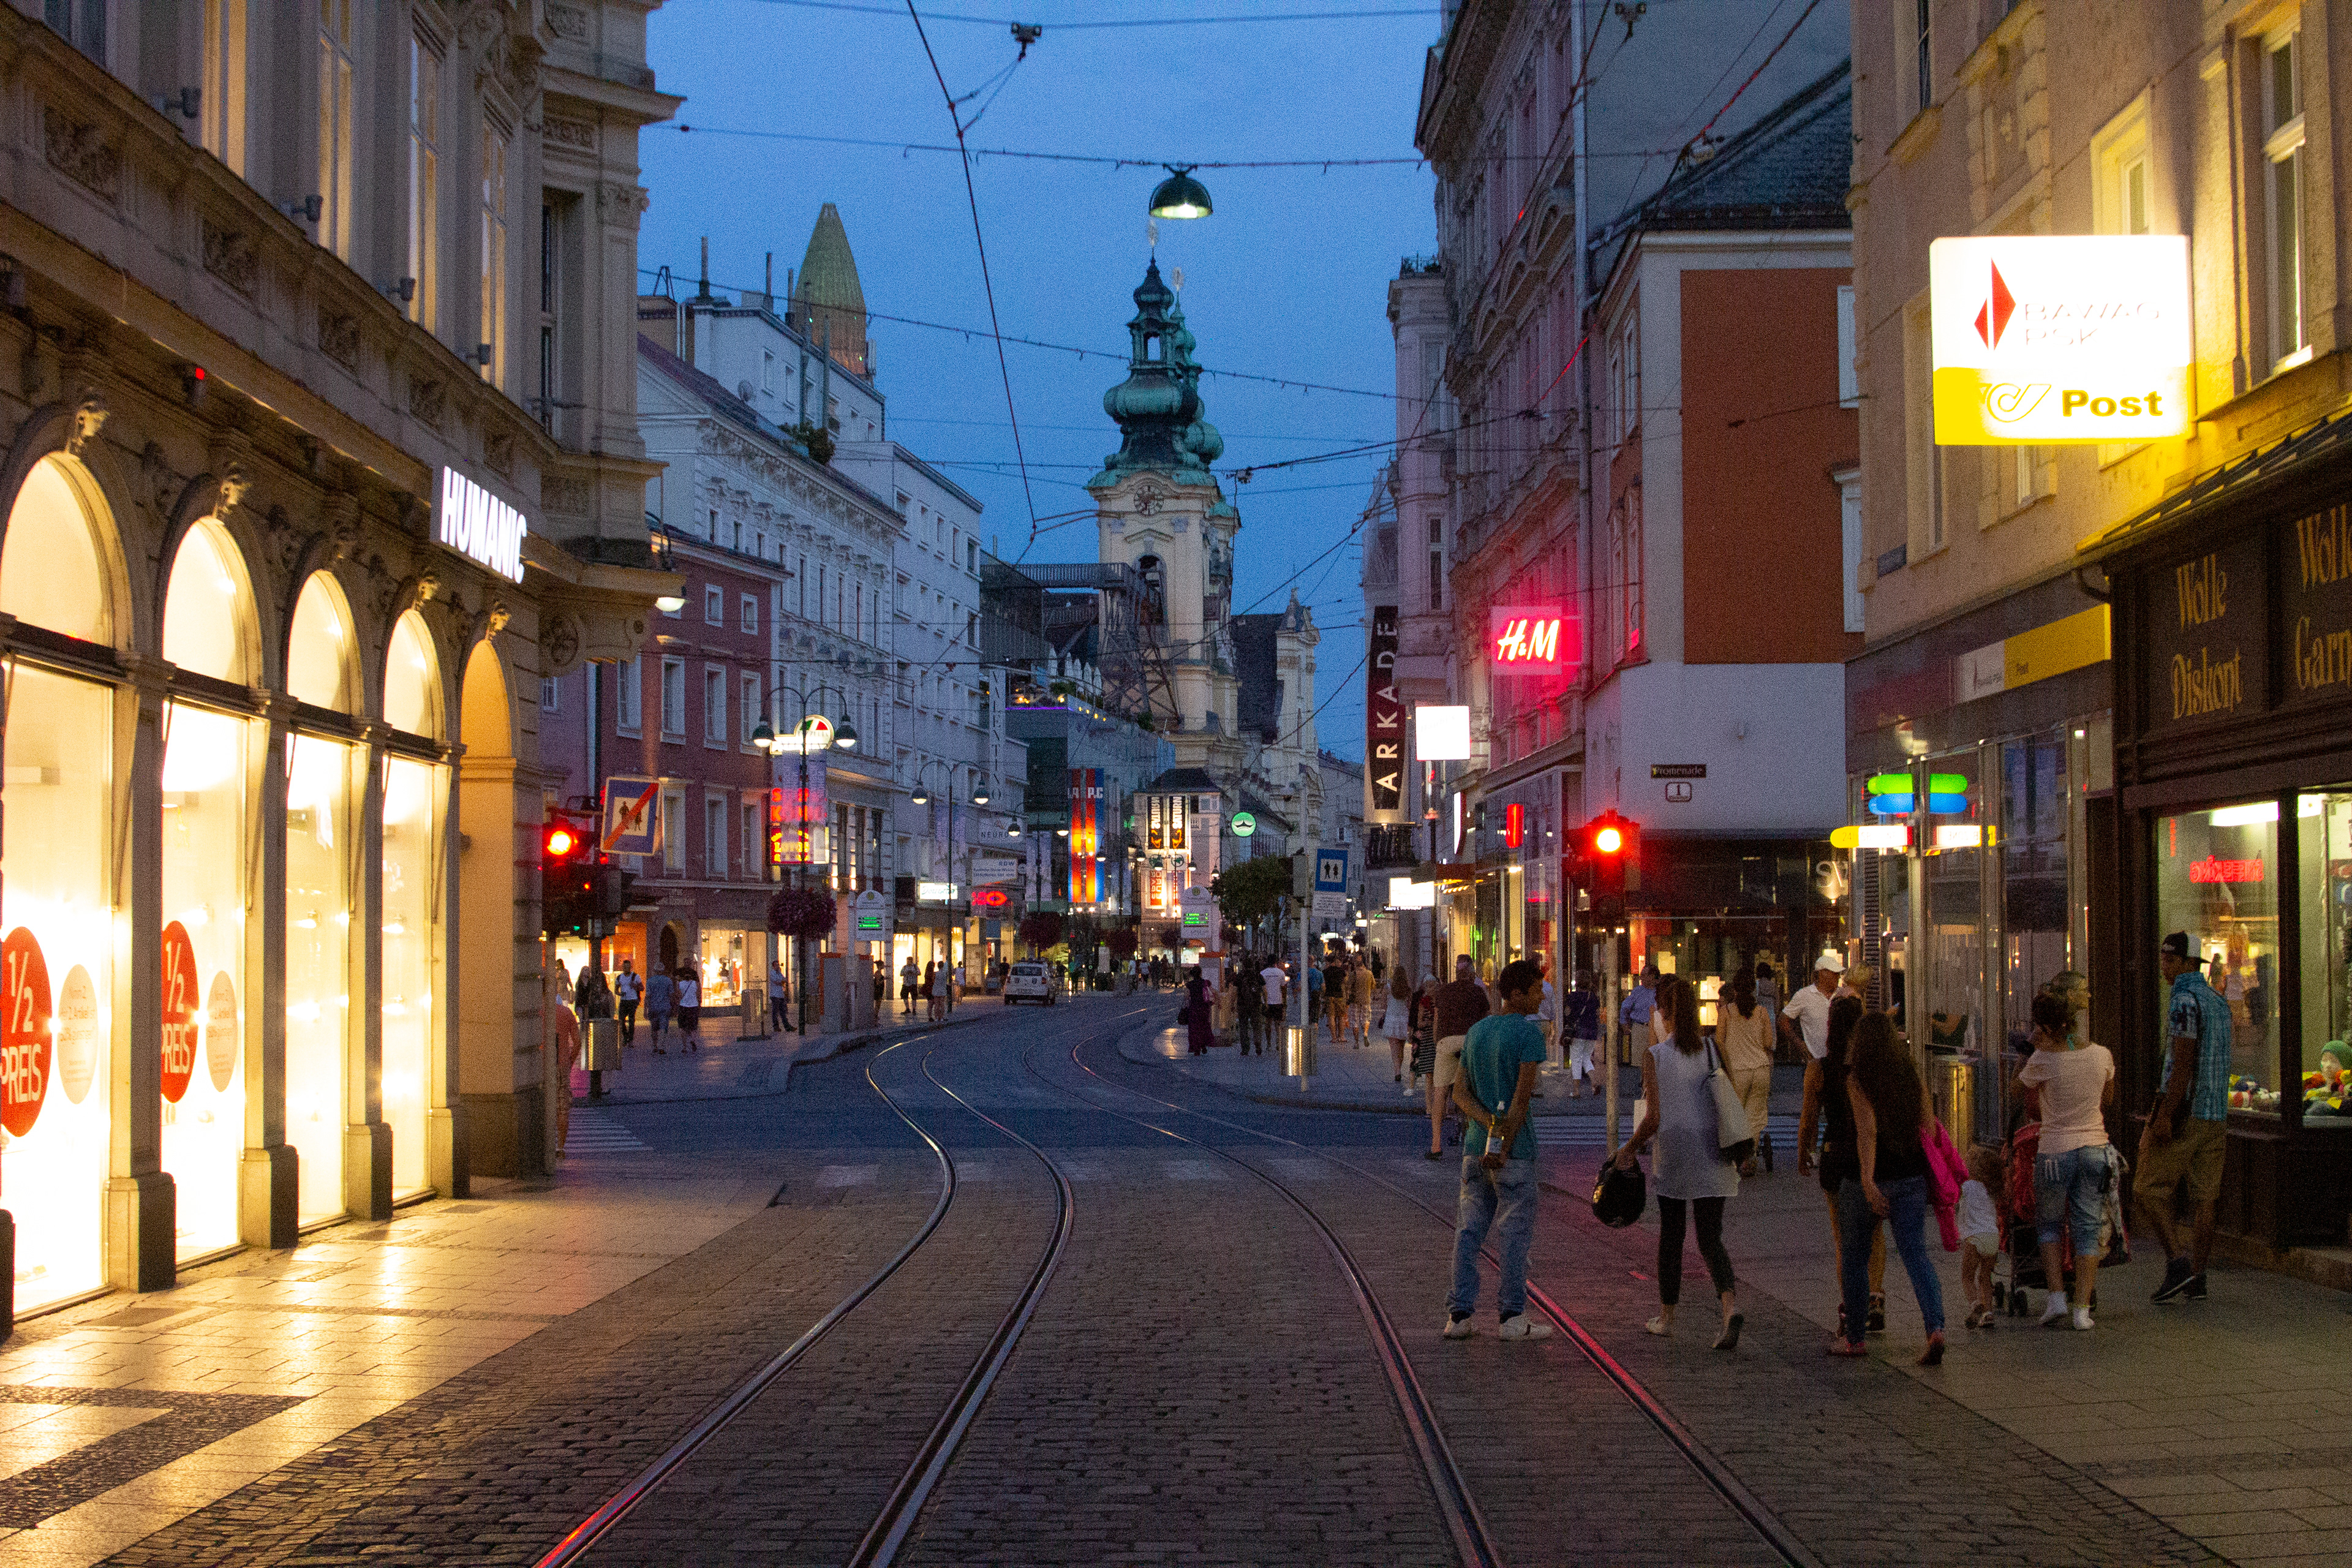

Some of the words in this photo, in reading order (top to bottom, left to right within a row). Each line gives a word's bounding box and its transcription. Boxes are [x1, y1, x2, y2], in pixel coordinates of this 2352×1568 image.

[2024, 302, 2160, 320] BAWAG
[2025, 328, 2098, 346] PSK
[2062, 390, 2163, 417] Post
[440, 466, 527, 584] HUMANIC
[2176, 554, 2227, 632] Wolle
[1497, 619, 1560, 662] H&M
[1376, 623, 1398, 792] ARKADE
[2171, 647, 2242, 719] Diskont
[1653, 766, 1703, 775] Promenade
[1172, 796, 1183, 829] SATURN
[9, 951, 34, 1033] 1/2
[166, 941, 185, 1013] 1/2
